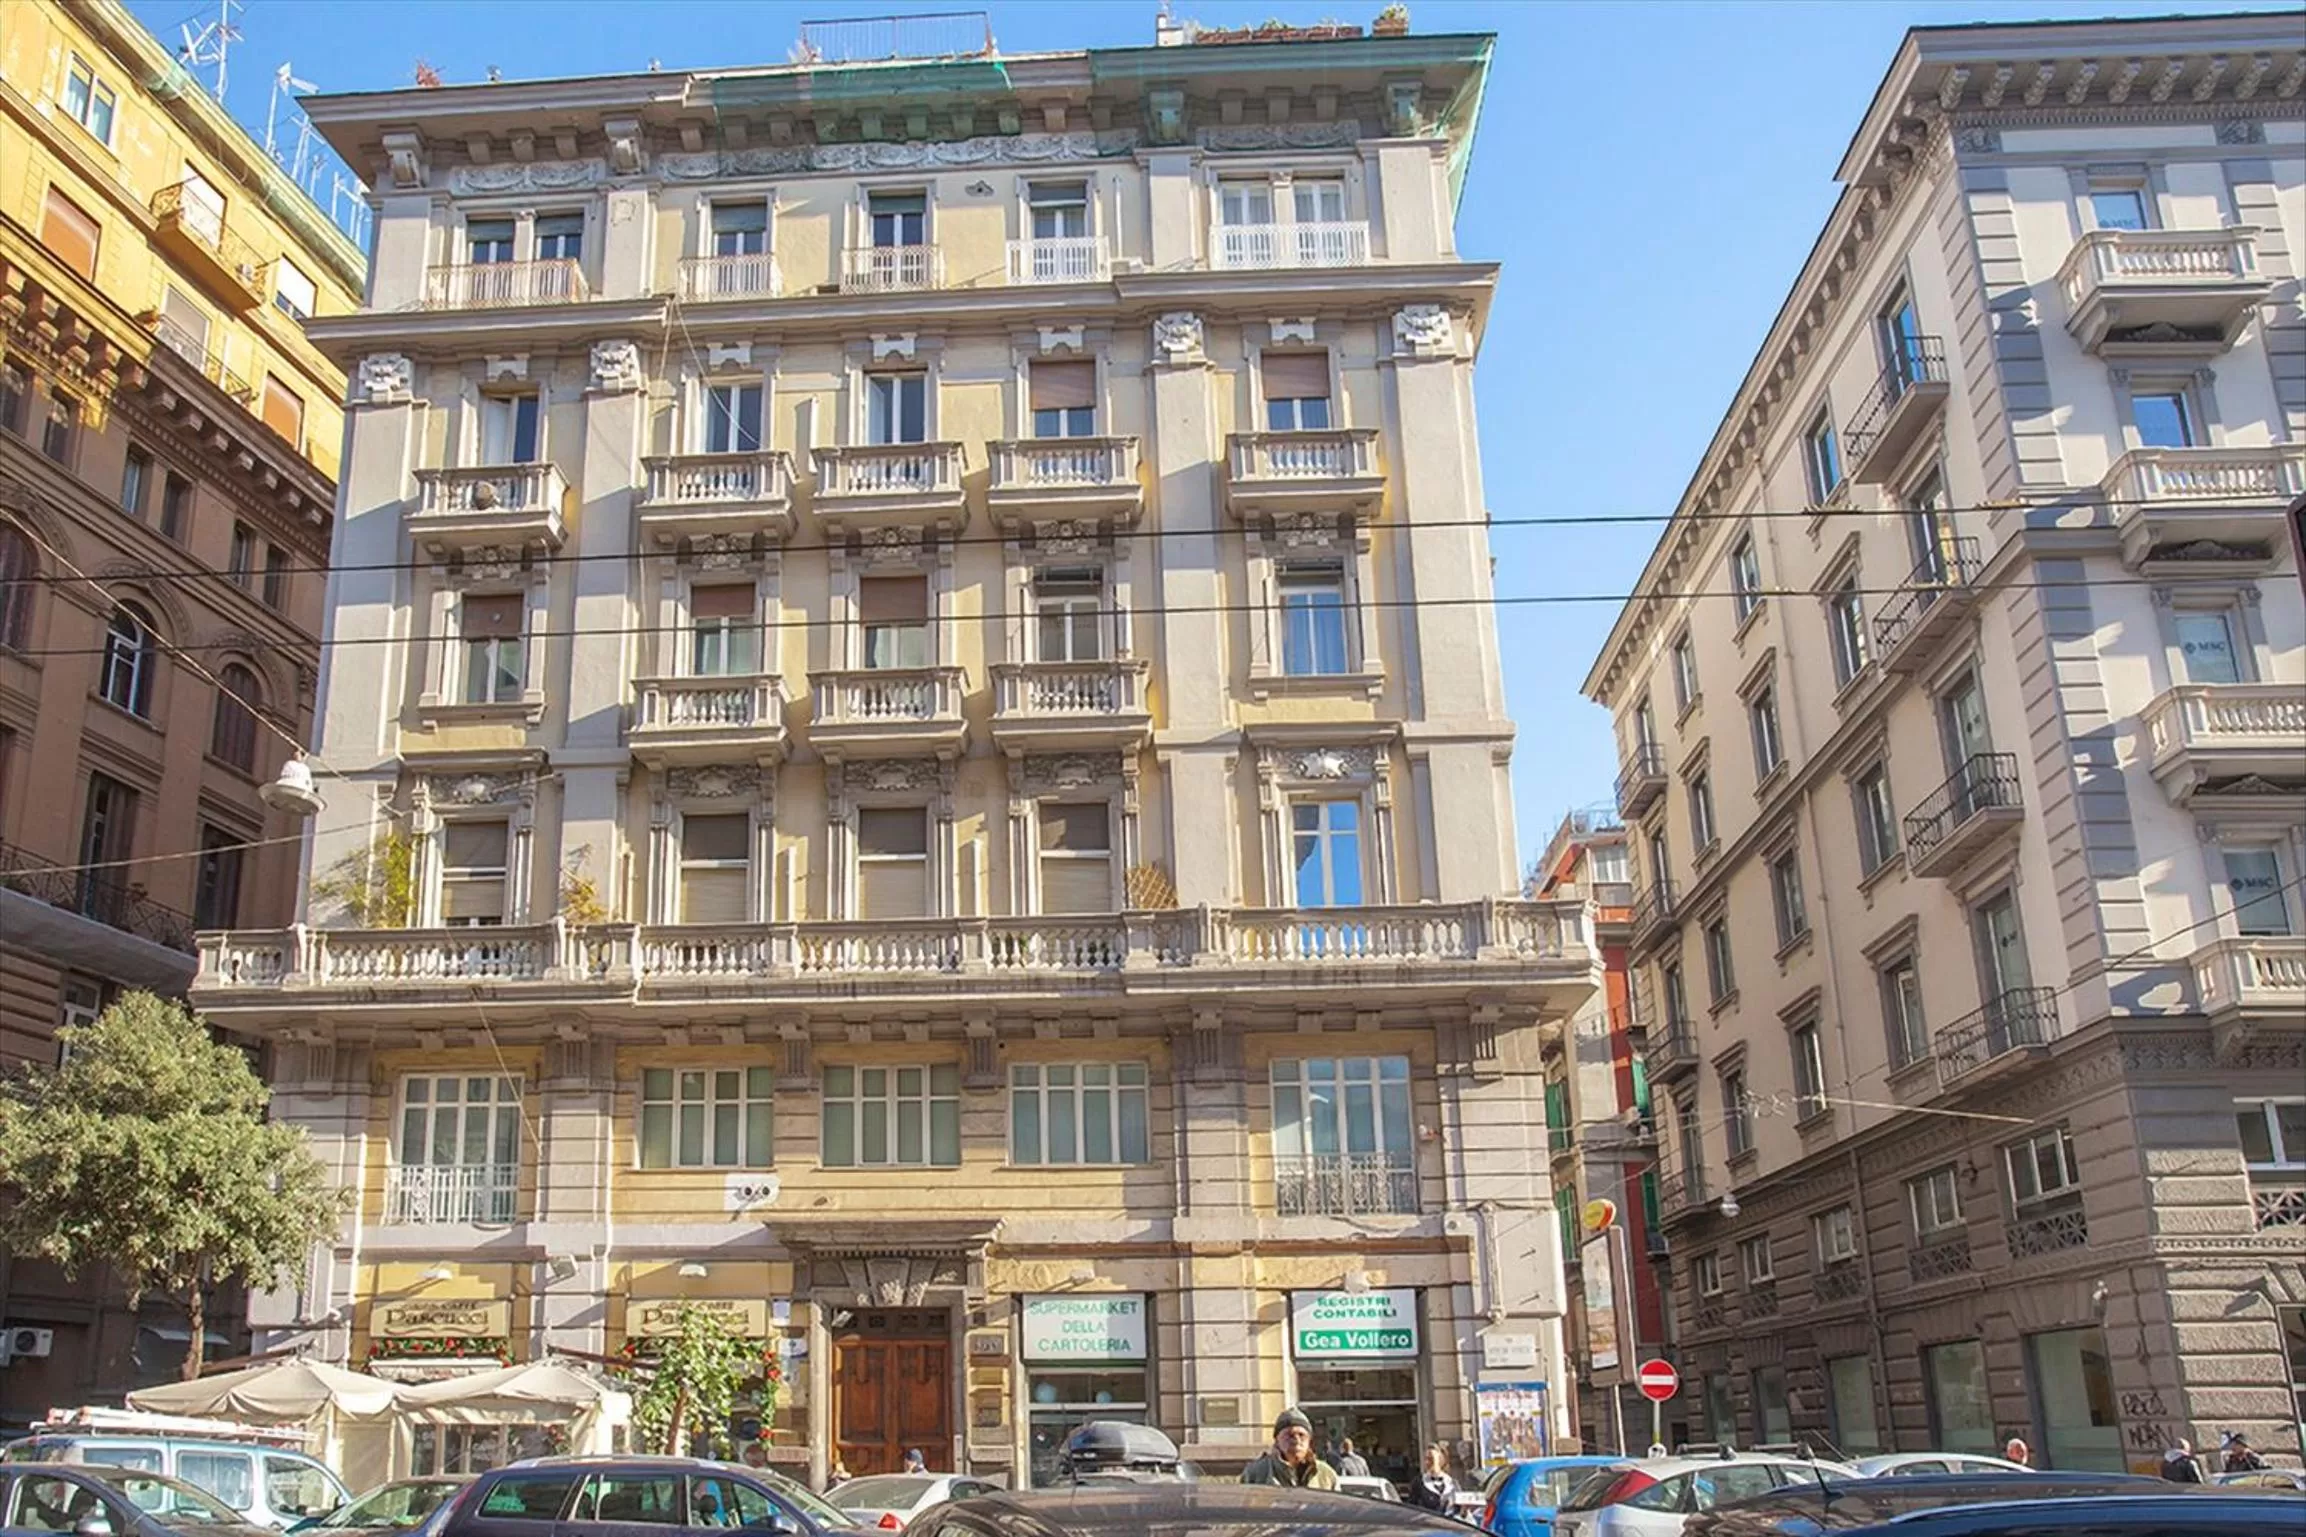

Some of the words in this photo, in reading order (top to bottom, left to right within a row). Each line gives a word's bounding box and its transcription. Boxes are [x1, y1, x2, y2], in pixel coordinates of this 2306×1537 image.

[2198, 641, 2225, 651] MSC
[2244, 877, 2273, 888] MSC
[1030, 1301, 1137, 1314] SUPERMARKET
[1317, 1296, 1391, 1306] REGISTRI
[386, 1309, 488, 1324] Pascucci
[1313, 1308, 1397, 1319] CONTABILI
[1062, 1320, 1105, 1333] DELLA
[1038, 1338, 1132, 1352] CARTOLERIA
[1305, 1332, 1340, 1348] Gea
[1345, 1331, 1409, 1348] Vollero
